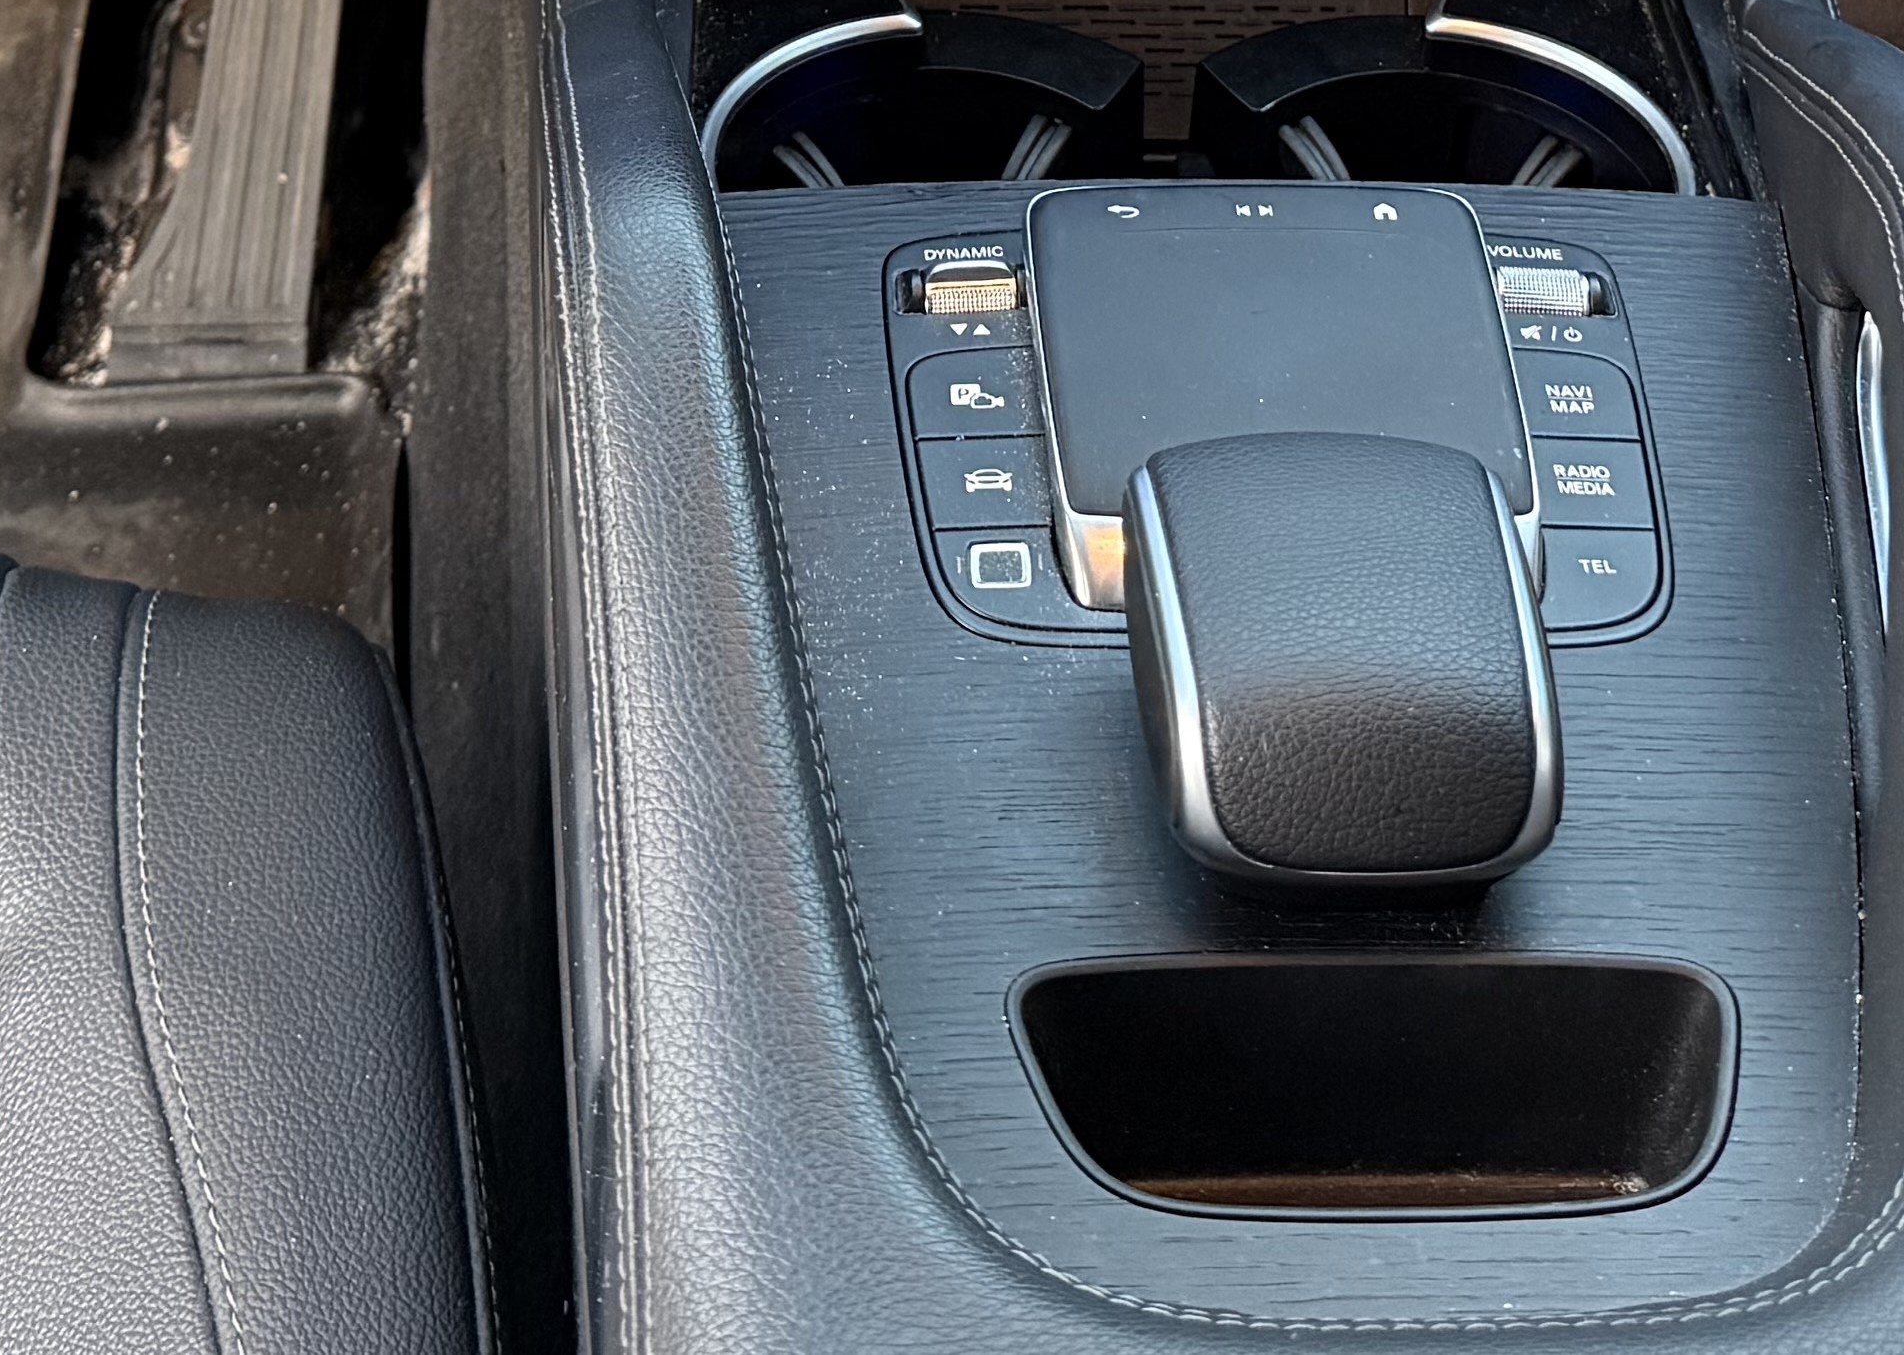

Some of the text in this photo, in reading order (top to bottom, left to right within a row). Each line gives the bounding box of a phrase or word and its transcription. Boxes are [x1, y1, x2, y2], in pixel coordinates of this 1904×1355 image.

[924, 246, 1004, 261] DYNAMIC
[1488, 245, 1563, 260] VOLUME
[1545, 384, 1593, 399] NAVI
[1550, 400, 1594, 414] MAP
[1553, 465, 1610, 479] RADIO
[1558, 482, 1615, 497] MEDIA
[1579, 560, 1616, 574] TEL
